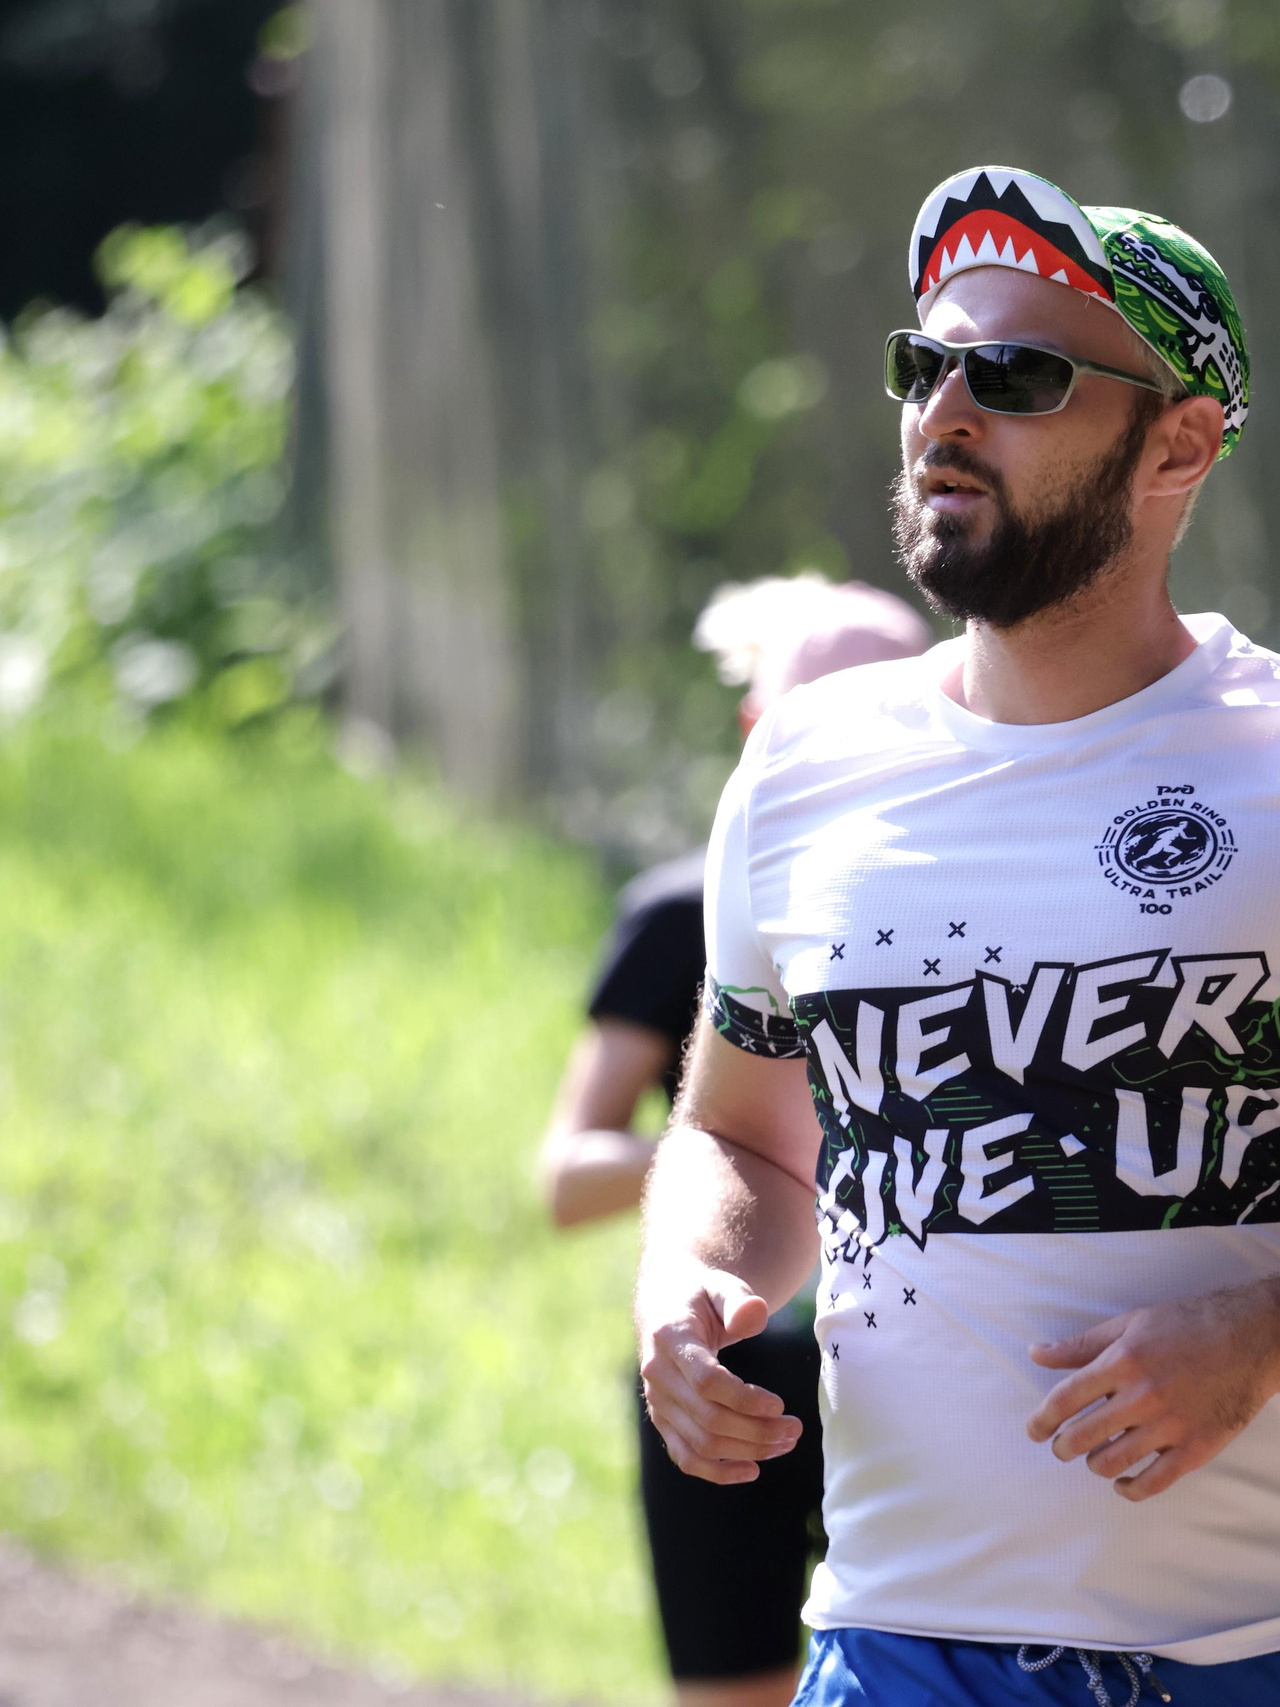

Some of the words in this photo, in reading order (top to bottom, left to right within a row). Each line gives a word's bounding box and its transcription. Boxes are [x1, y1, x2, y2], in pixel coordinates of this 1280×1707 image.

[1113, 798, 1185, 825] GOLDEN
[1190, 801, 1227, 828] RING
[1104, 867, 1156, 900] ULTRA
[1165, 873, 1223, 900] TRAIL
[1139, 903, 1173, 915] 100
[811, 951, 1271, 1129] NEVER
